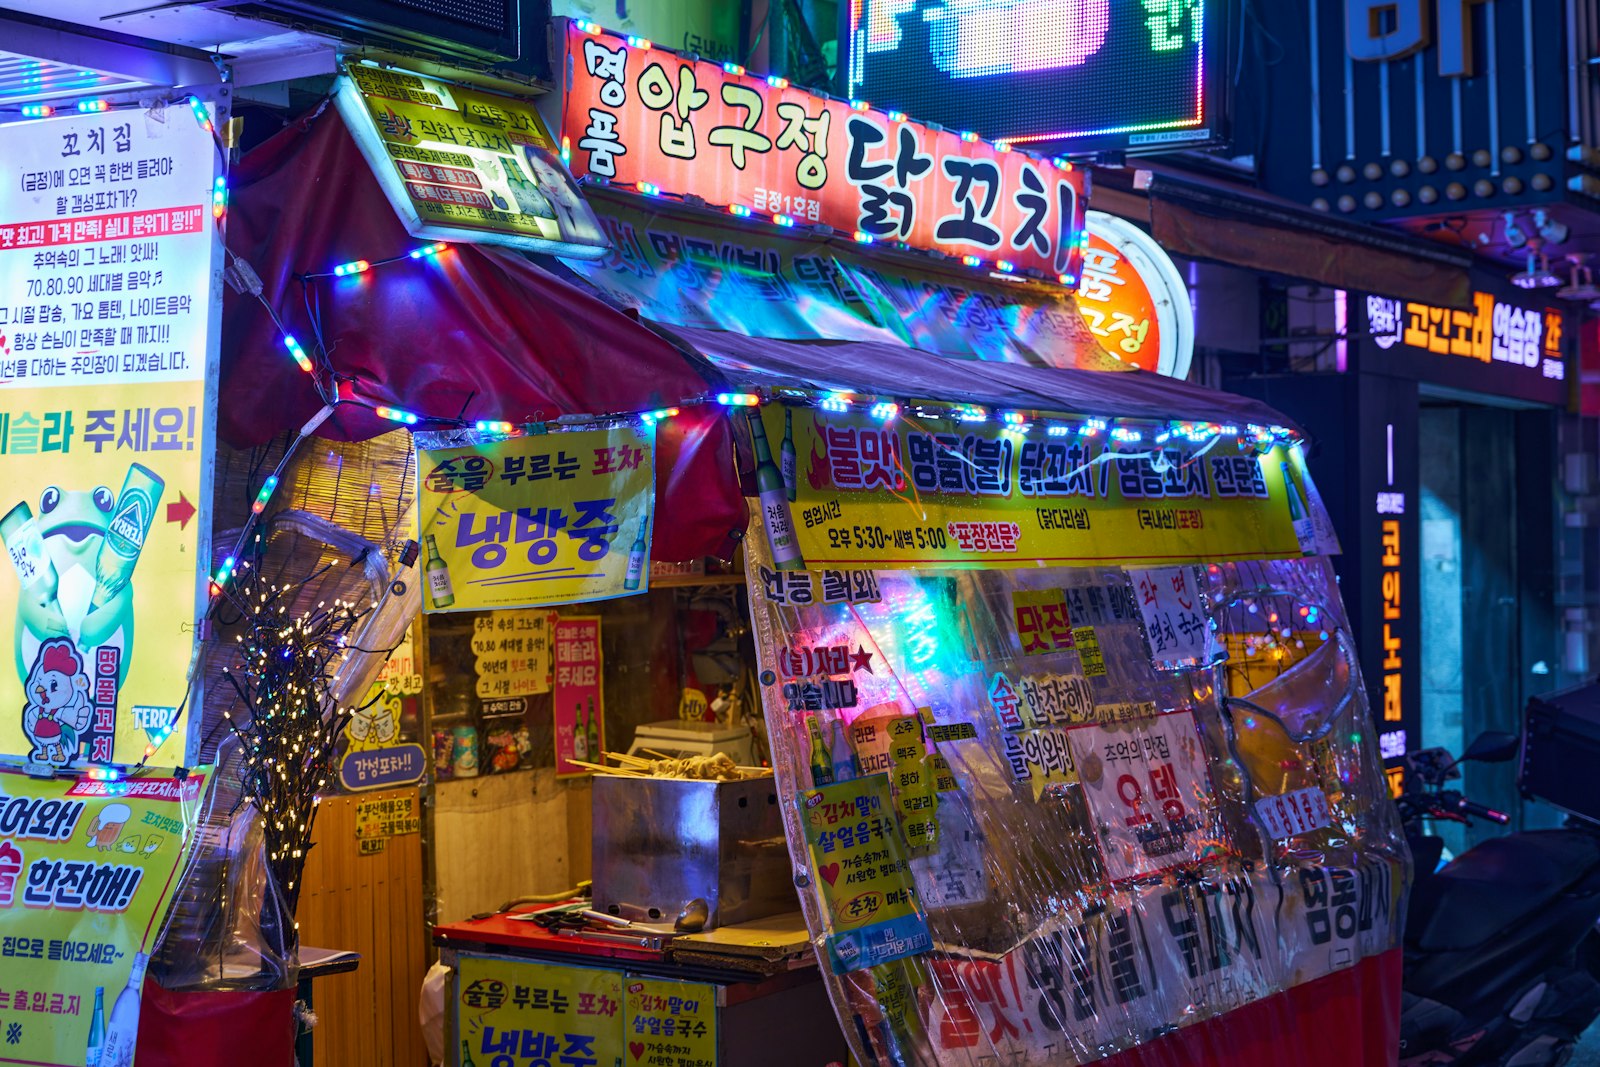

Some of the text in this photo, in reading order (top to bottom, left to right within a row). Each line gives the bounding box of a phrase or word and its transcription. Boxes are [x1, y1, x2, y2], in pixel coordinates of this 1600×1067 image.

[578, 38, 627, 177] 명품
[418, 117, 456, 145] 직화
[457, 126, 516, 154] 닭꼬치
[21, 157, 173, 192] (금정)에 오면 꼭 한번 들려야
[637, 62, 1076, 273] 압구정 닭꼬치
[56, 189, 138, 215] 할 갬성포차가?
[754, 187, 821, 222] 금정1호점
[17, 225, 45, 245] 최고!
[48, 223, 71, 242] 가격
[74, 220, 102, 241] 만족!
[105, 218, 129, 236] 실내
[132, 214, 168, 234] 분위기
[33, 242, 159, 269] 추억속의 그 노래! 앗싸!
[27, 276, 83, 297] 70.80.90
[87, 272, 123, 292] 세대별
[12, 303, 35, 325] 시절
[39, 303, 66, 324] 팝송,
[71, 302, 94, 320] 가요
[98, 299, 126, 320] 톱텐,
[129, 295, 191, 317] 나이트음악
[14, 324, 170, 351] 항상 손님이 만족할 때 까지!!
[1492, 302, 1542, 368] 연습장
[0, 351, 189, 378] 선을 다하는 주인장이 되겠습니다.
[84, 406, 196, 453] 주세요!
[429, 445, 644, 492] 술을 부르는 포차
[827, 428, 905, 491] 불맛!
[908, 433, 1012, 494] 명품(불)
[1019, 443, 1094, 495] 닭꼬치
[1213, 457, 1267, 496] 전문점
[767, 504, 785, 520] 처음
[803, 500, 841, 528] 영업시간
[456, 498, 619, 570] 냉방중
[828, 528, 852, 548] 오후
[916, 527, 946, 549] 5:00
[1037, 508, 1090, 530] (닭다리살)
[476, 618, 494, 632] 추억
[1016, 602, 1073, 652] 맛집
[1149, 612, 1205, 653] 멸치 국수
[558, 641, 596, 662] 테슬라
[482, 659, 508, 673] 90년대
[558, 666, 596, 688] 주세요
[390, 676, 421, 691] 맛 최고
[481, 680, 538, 695] 그 시절 나이트
[92, 650, 117, 762] 명품꼬치
[991, 677, 1019, 730] 술
[855, 725, 876, 743] 라면
[895, 721, 915, 735] 소주
[896, 746, 917, 760] 맥주
[1105, 734, 1170, 768] 추억의 맛집
[355, 753, 412, 781] 감성포차!!
[900, 771, 920, 786] 청하
[903, 795, 933, 810] 막걸리
[1117, 763, 1186, 827] 오뎅
[821, 796, 881, 825] 김치말이
[818, 818, 894, 852] 살얼음국수
[842, 849, 890, 869] 가슴속까지
[25, 860, 141, 907] 한잔해!
[846, 868, 877, 885] 시원한
[850, 896, 878, 916] 추천
[48, 939, 124, 964] 들어오세요~
[464, 979, 618, 1018] 술을 부르는 포차
[639, 994, 699, 1015] 김치말이
[929, 951, 1033, 1049] 불맛!
[632, 1015, 707, 1039] 살얼음국수
[647, 1042, 691, 1056] 가슴속까지
[648, 1055, 673, 1067] 시원한
